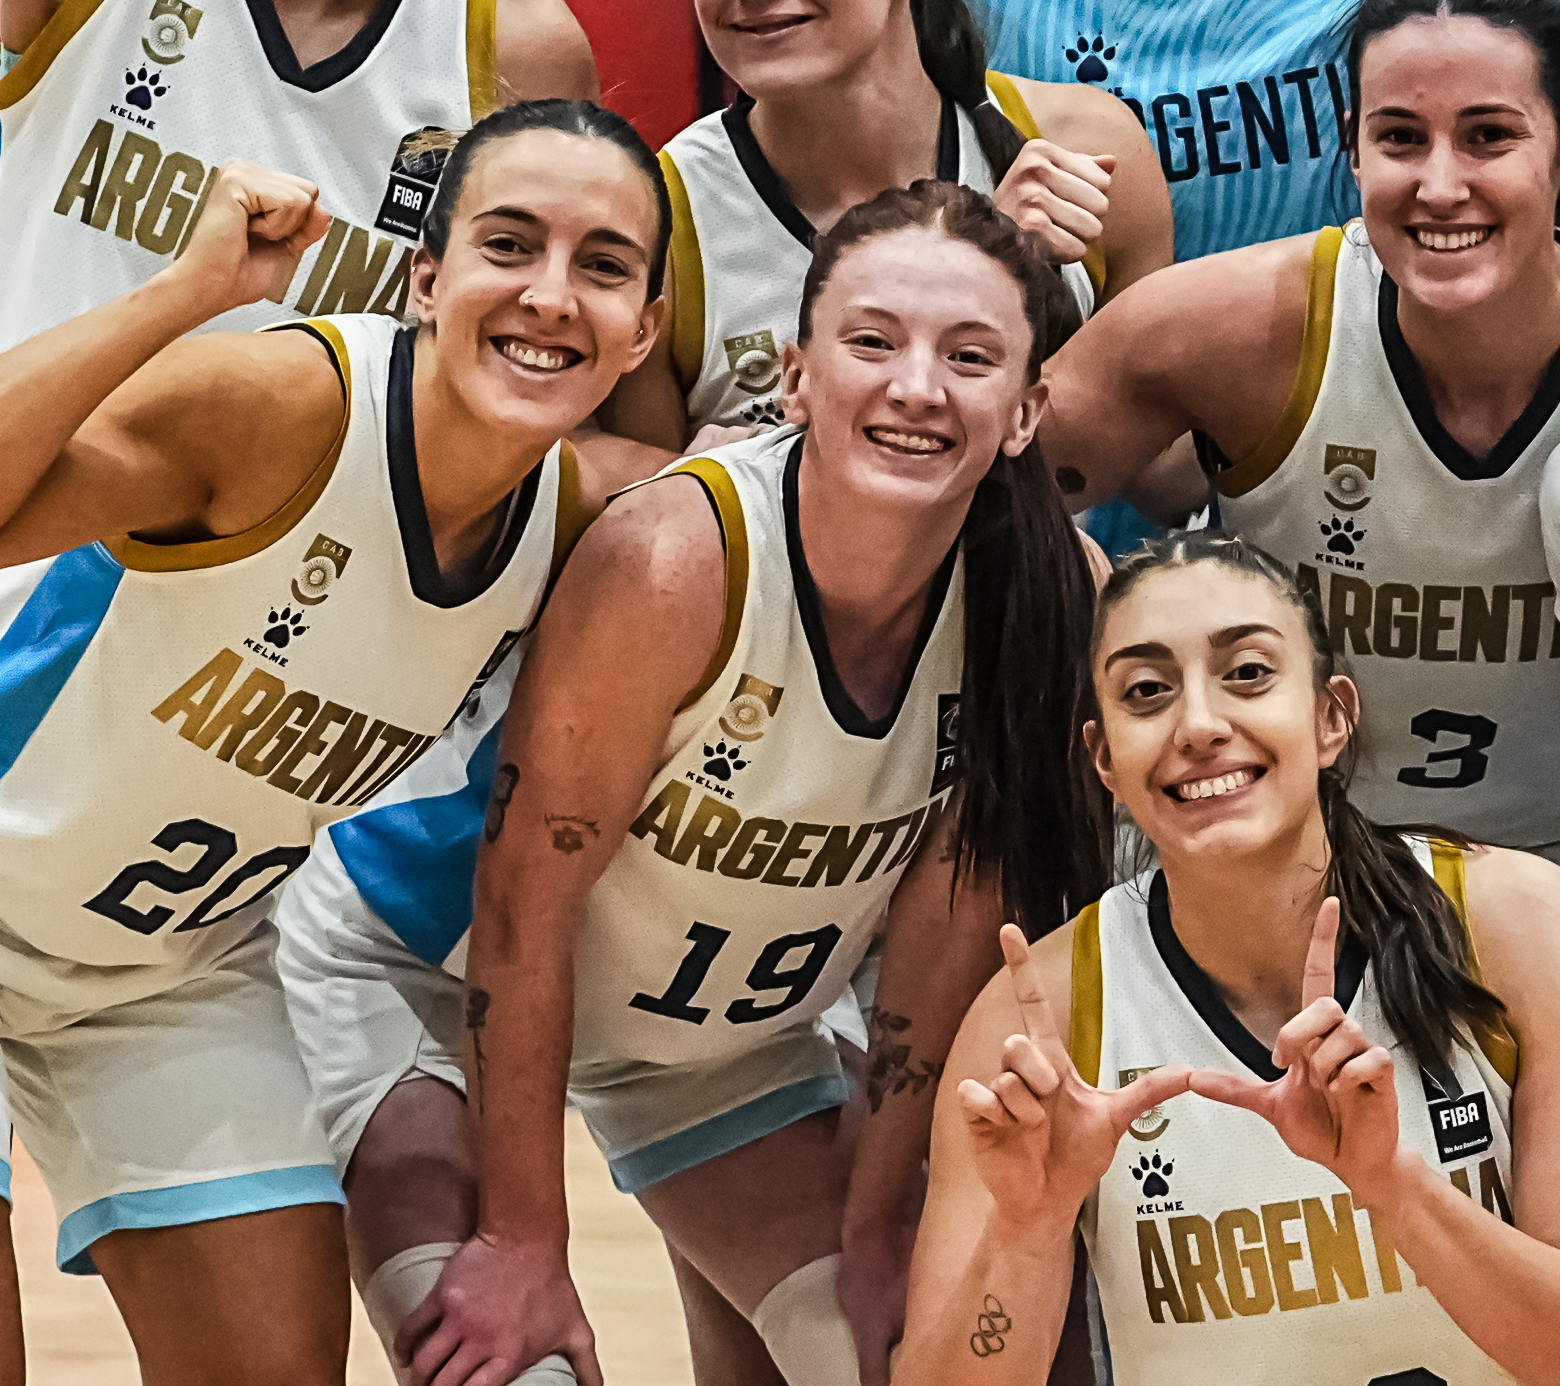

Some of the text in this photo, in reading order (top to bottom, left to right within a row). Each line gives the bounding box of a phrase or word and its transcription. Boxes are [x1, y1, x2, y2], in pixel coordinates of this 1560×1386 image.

[109, 103, 157, 131] KELME
[392, 184, 423, 211] FIBA
[53, 118, 416, 315] ARGINA
[321, 540, 345, 557] CAB
[1315, 552, 1366, 571] KELME
[243, 638, 289, 668] KELME
[151, 647, 439, 807] ARGENTI
[1396, 708, 1499, 789] 3
[685, 770, 735, 800] KELME
[628, 778, 942, 888] ARGENTI
[81, 817, 311, 936] 20
[627, 920, 843, 1026] 19
[1439, 1102, 1480, 1130] FIBA
[1136, 1200, 1185, 1215] KELME
